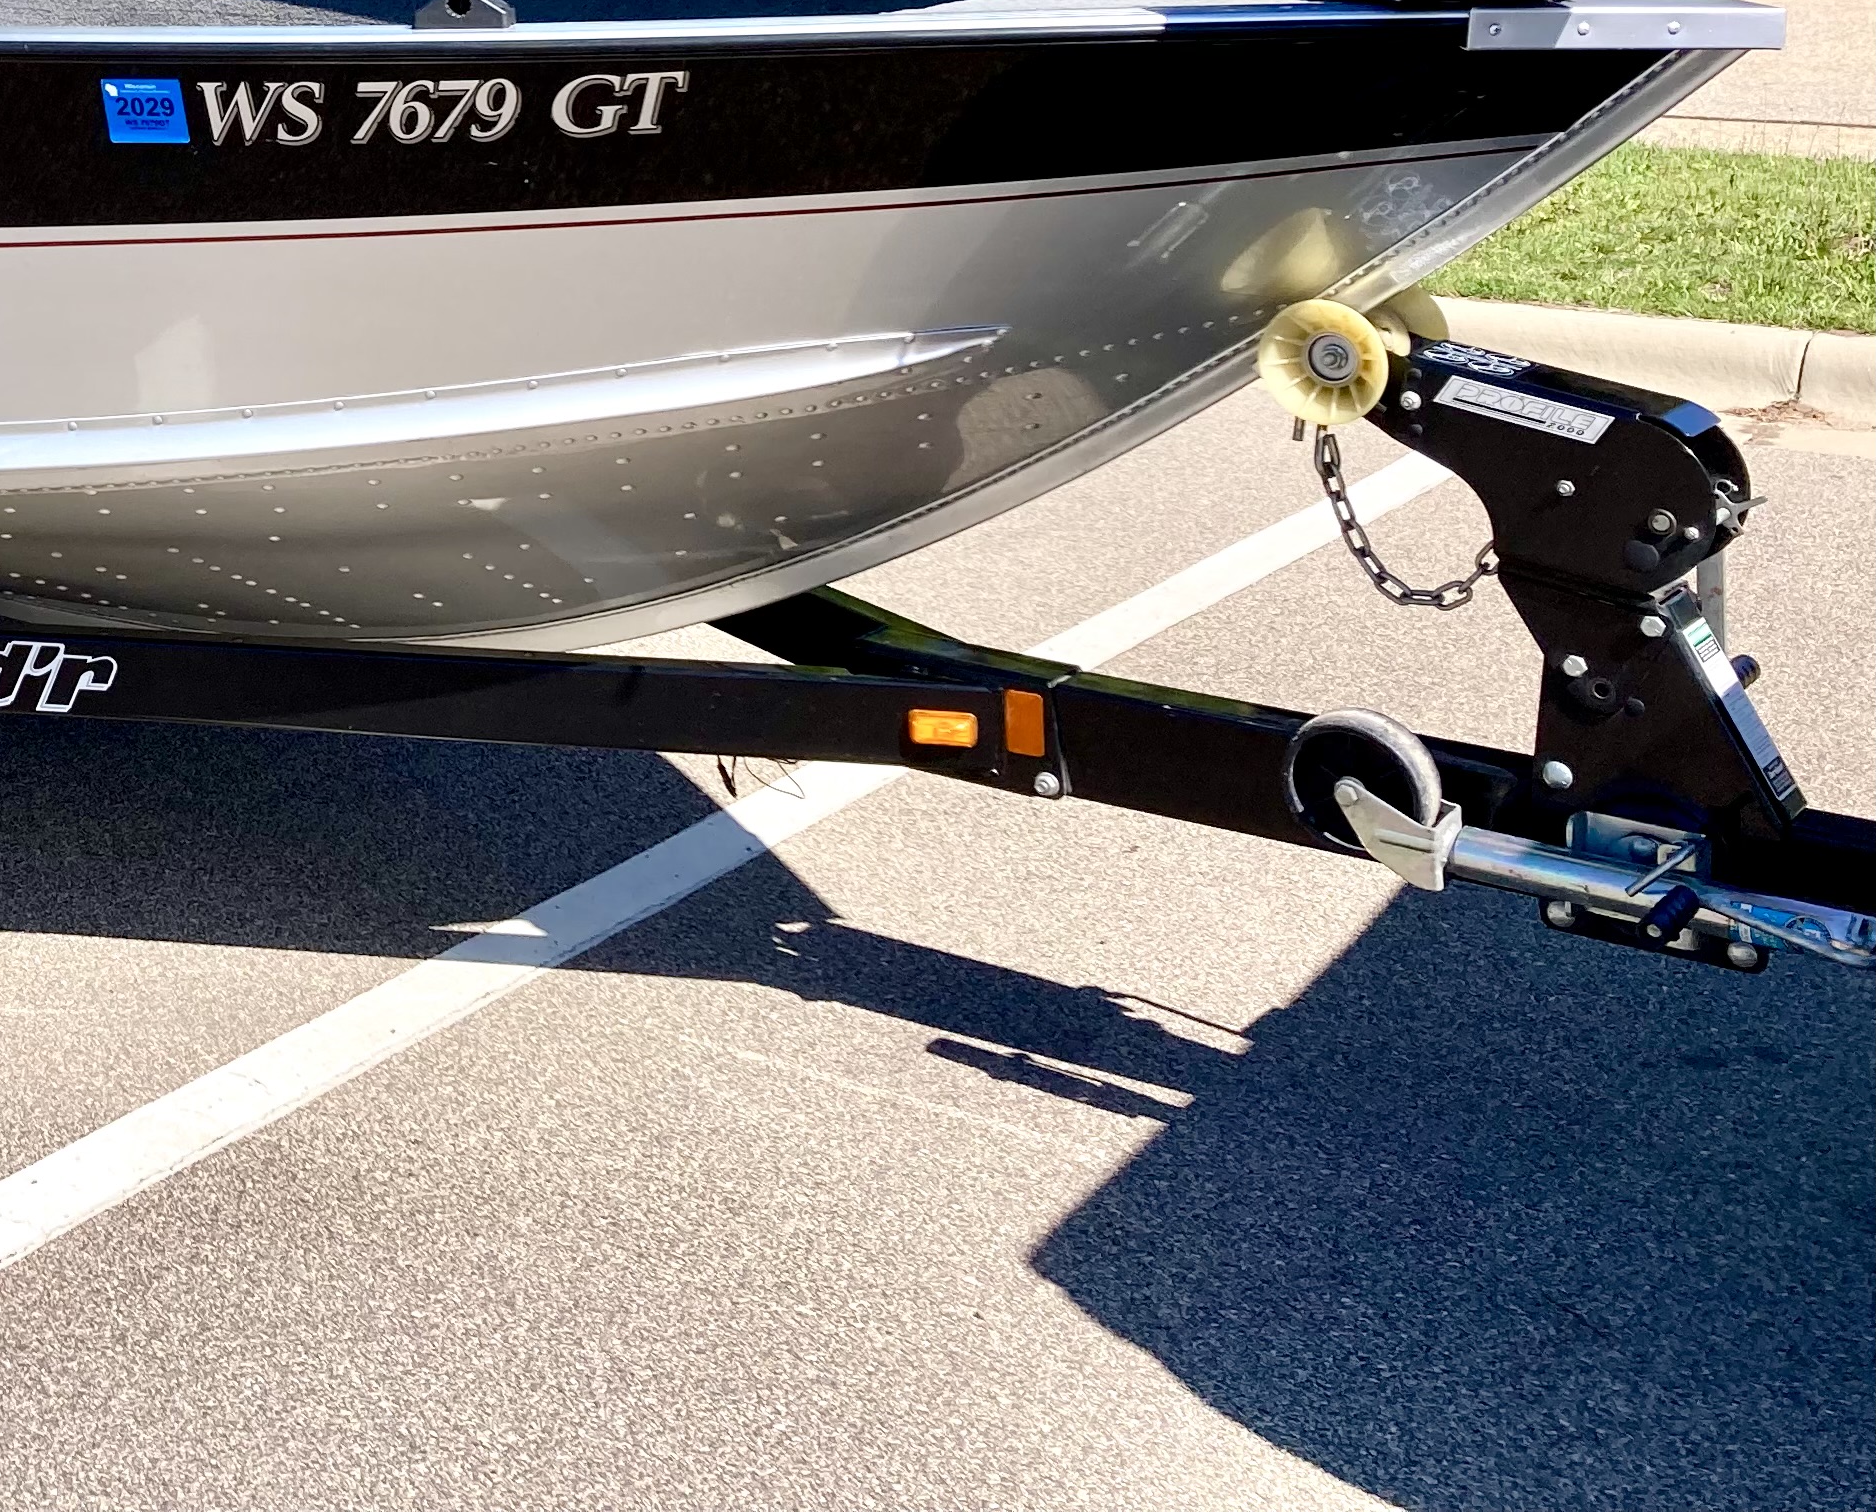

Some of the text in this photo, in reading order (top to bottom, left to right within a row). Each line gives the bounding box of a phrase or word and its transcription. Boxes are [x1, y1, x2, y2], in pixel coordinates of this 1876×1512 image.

[114, 96, 176, 118] 2029
[196, 69, 691, 147] WS 7679 GT
[1454, 383, 1597, 431] PROFILE
[1545, 421, 1586, 436] 2000
